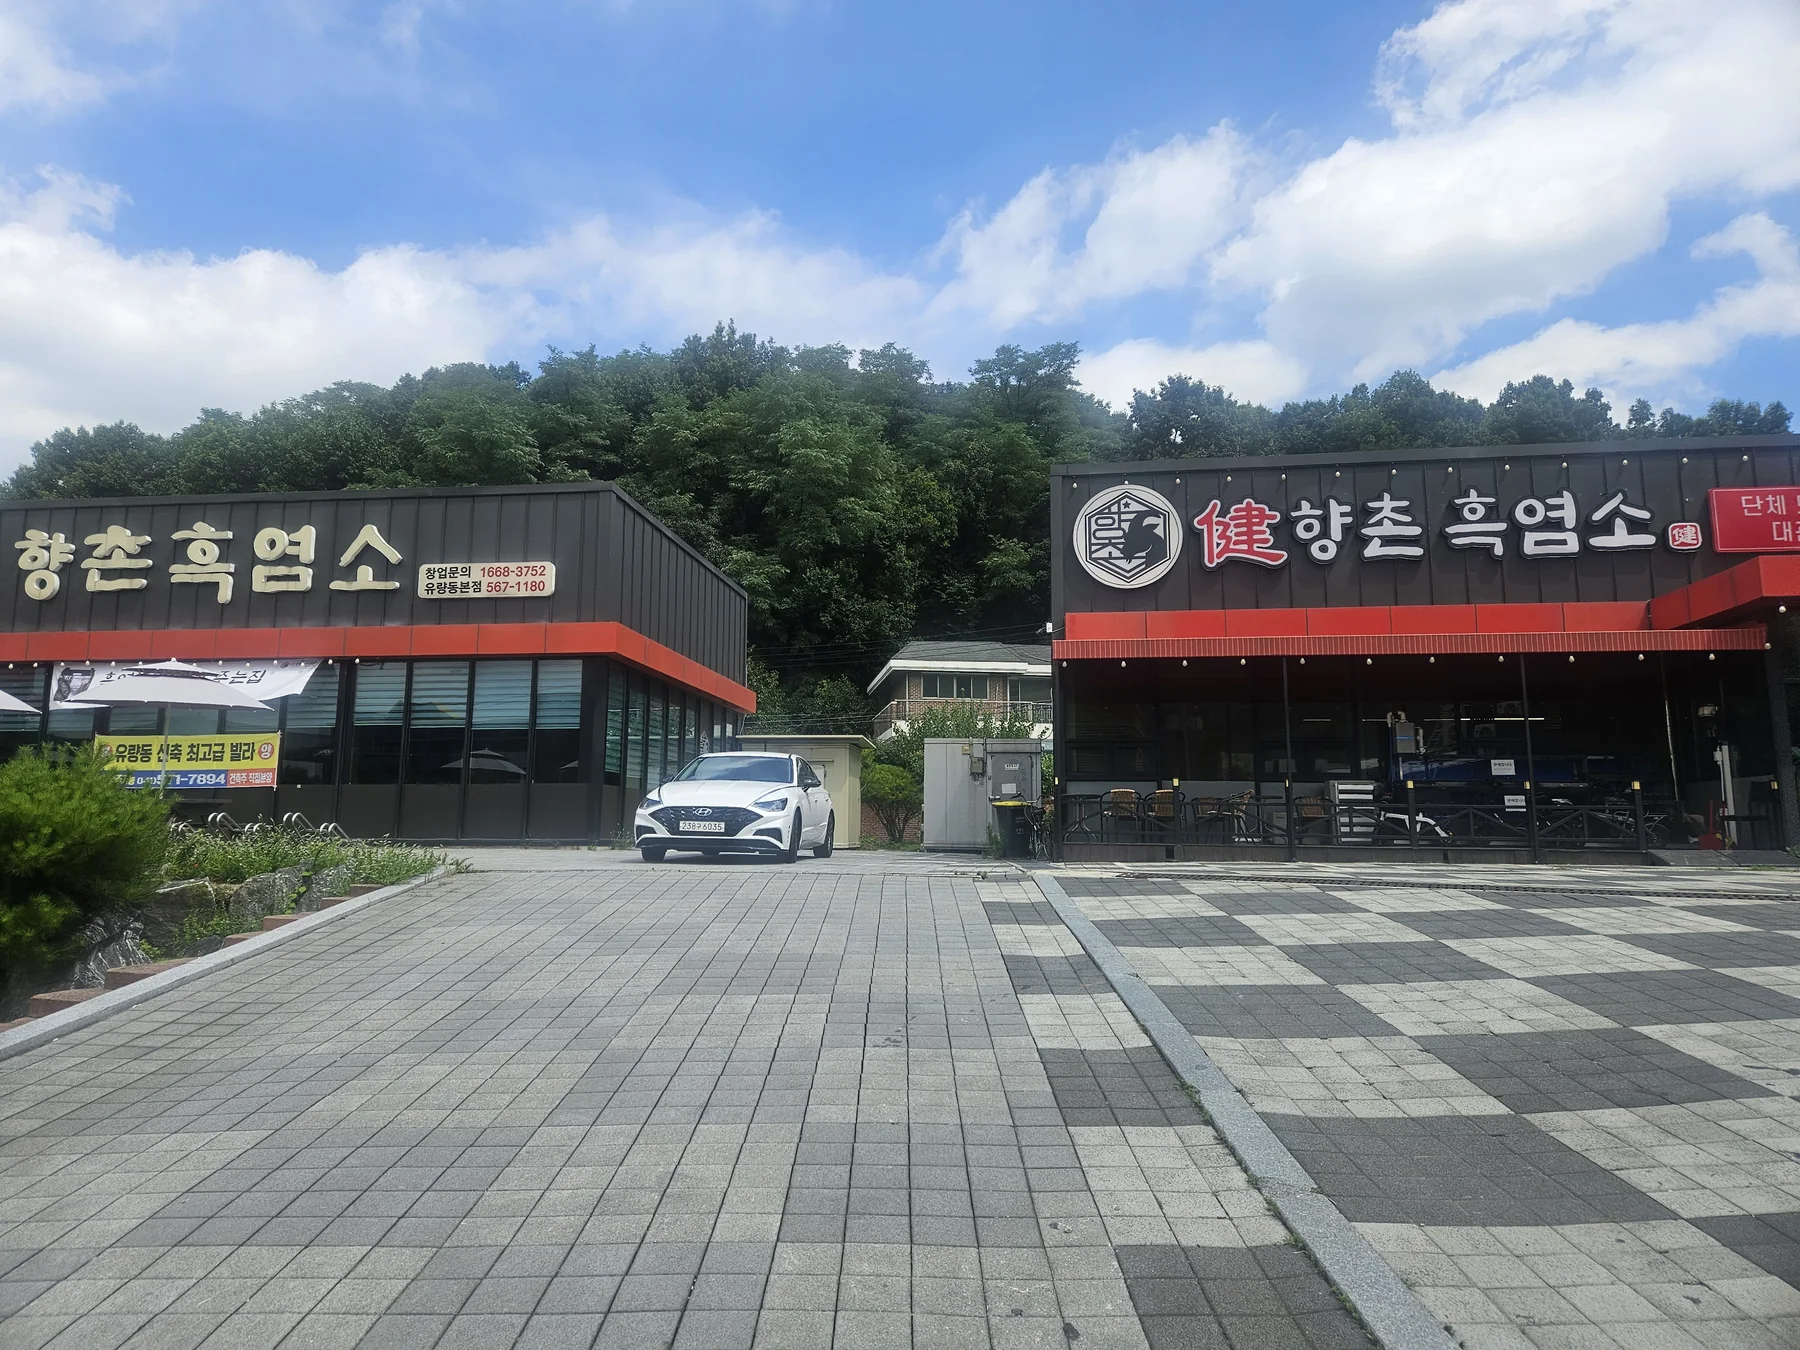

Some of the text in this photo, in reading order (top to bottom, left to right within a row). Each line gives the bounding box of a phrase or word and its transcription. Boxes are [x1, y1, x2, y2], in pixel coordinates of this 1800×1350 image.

[1741, 494, 1787, 516] 단체
[1772, 521, 1800, 541] 대
[425, 565, 546, 579] 창업문의 1668-3752
[424, 580, 546, 595] 유량동본점 567-1180
[114, 743, 152, 762] 유량동
[156, 743, 182, 762] 신축
[186, 742, 226, 762] 최고급
[229, 742, 255, 761] 빌라
